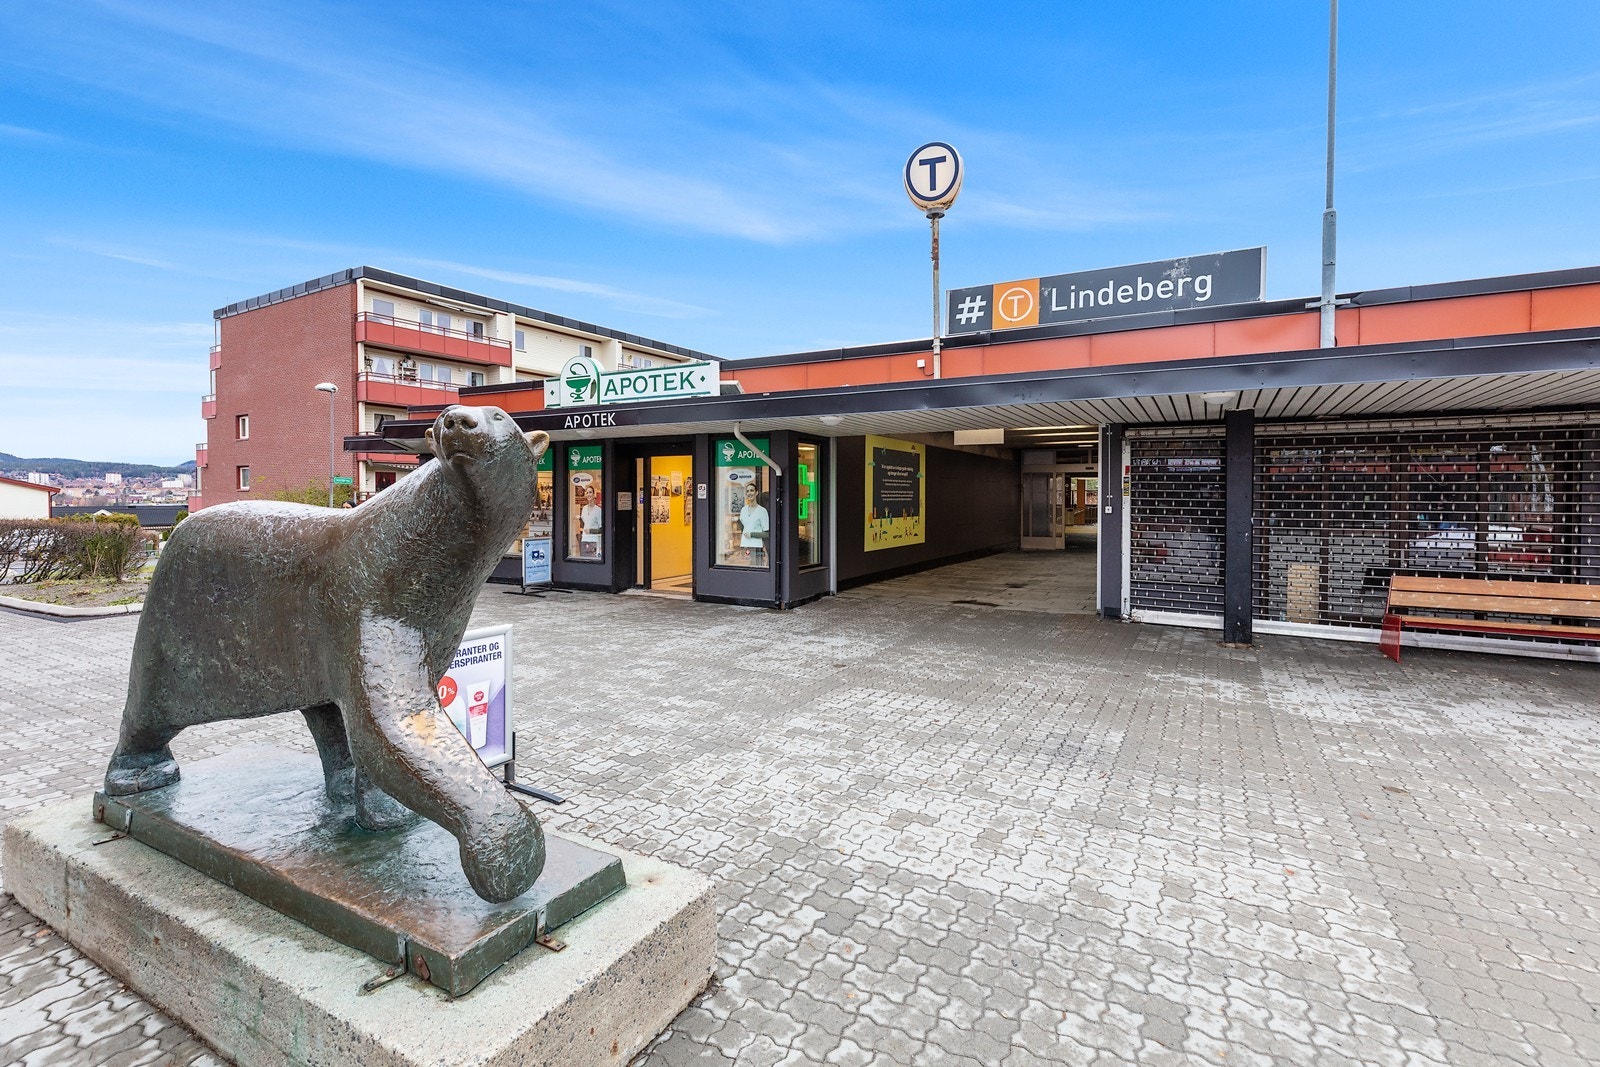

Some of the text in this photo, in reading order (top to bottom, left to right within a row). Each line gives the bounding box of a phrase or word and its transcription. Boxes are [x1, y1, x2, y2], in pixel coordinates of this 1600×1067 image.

[919, 155, 947, 191] T
[1050, 273, 1213, 312] Lindeberg
[604, 370, 696, 396] APOTEK
[564, 412, 616, 429] APOTEK
[737, 450, 765, 459] APOT
[456, 642, 499, 658] RANTER OG
[450, 651, 502, 669] ERSPIRANTER
[439, 685, 455, 700] 0%
